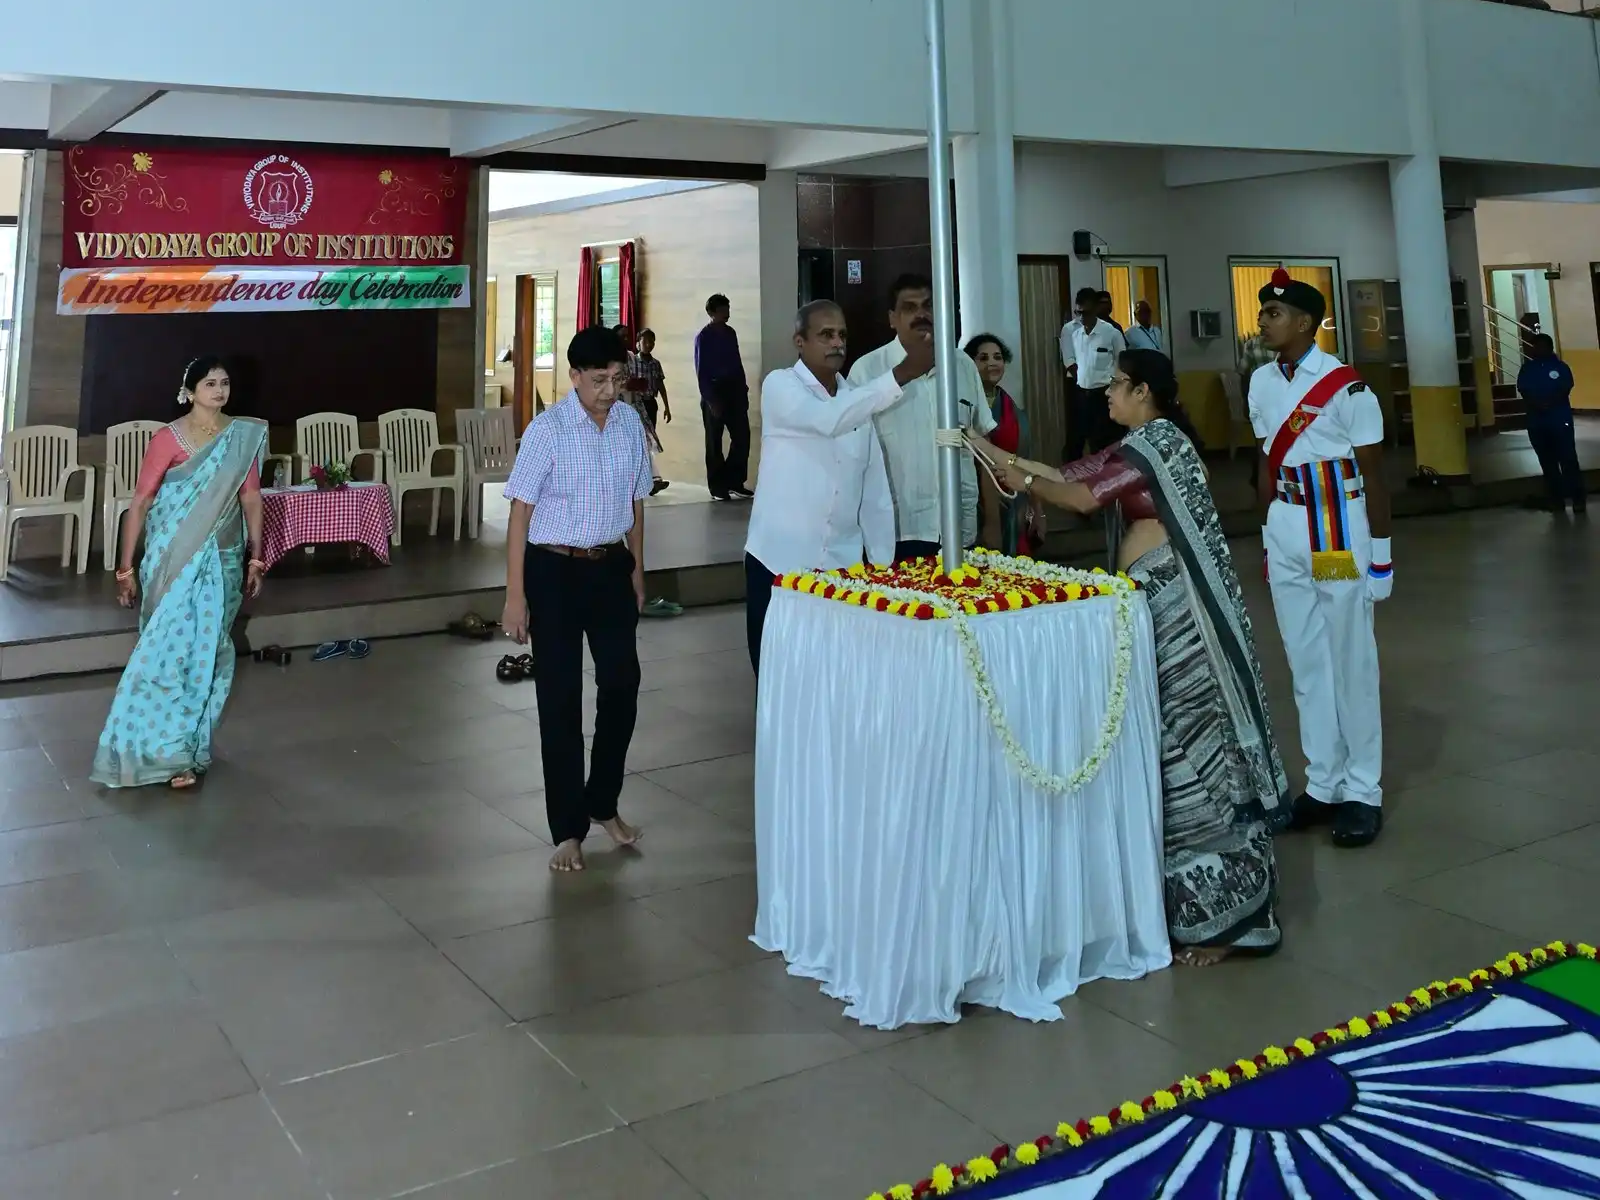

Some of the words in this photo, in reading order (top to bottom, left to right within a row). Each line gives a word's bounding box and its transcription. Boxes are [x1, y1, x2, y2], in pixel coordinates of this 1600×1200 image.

[243, 169, 257, 209] VIDYODAYA
[254, 155, 277, 171] GROUP
[278, 155, 290, 164] OF
[291, 160, 314, 214] INSTITUTIONS
[75, 232, 205, 260] VIDYODAYA
[206, 231, 280, 259] GROUP
[283, 232, 312, 258] OF
[315, 233, 454, 261] INSTITUTIONS
[76, 273, 297, 310] Independence
[300, 270, 350, 306] day
[350, 272, 463, 302] Celebration
